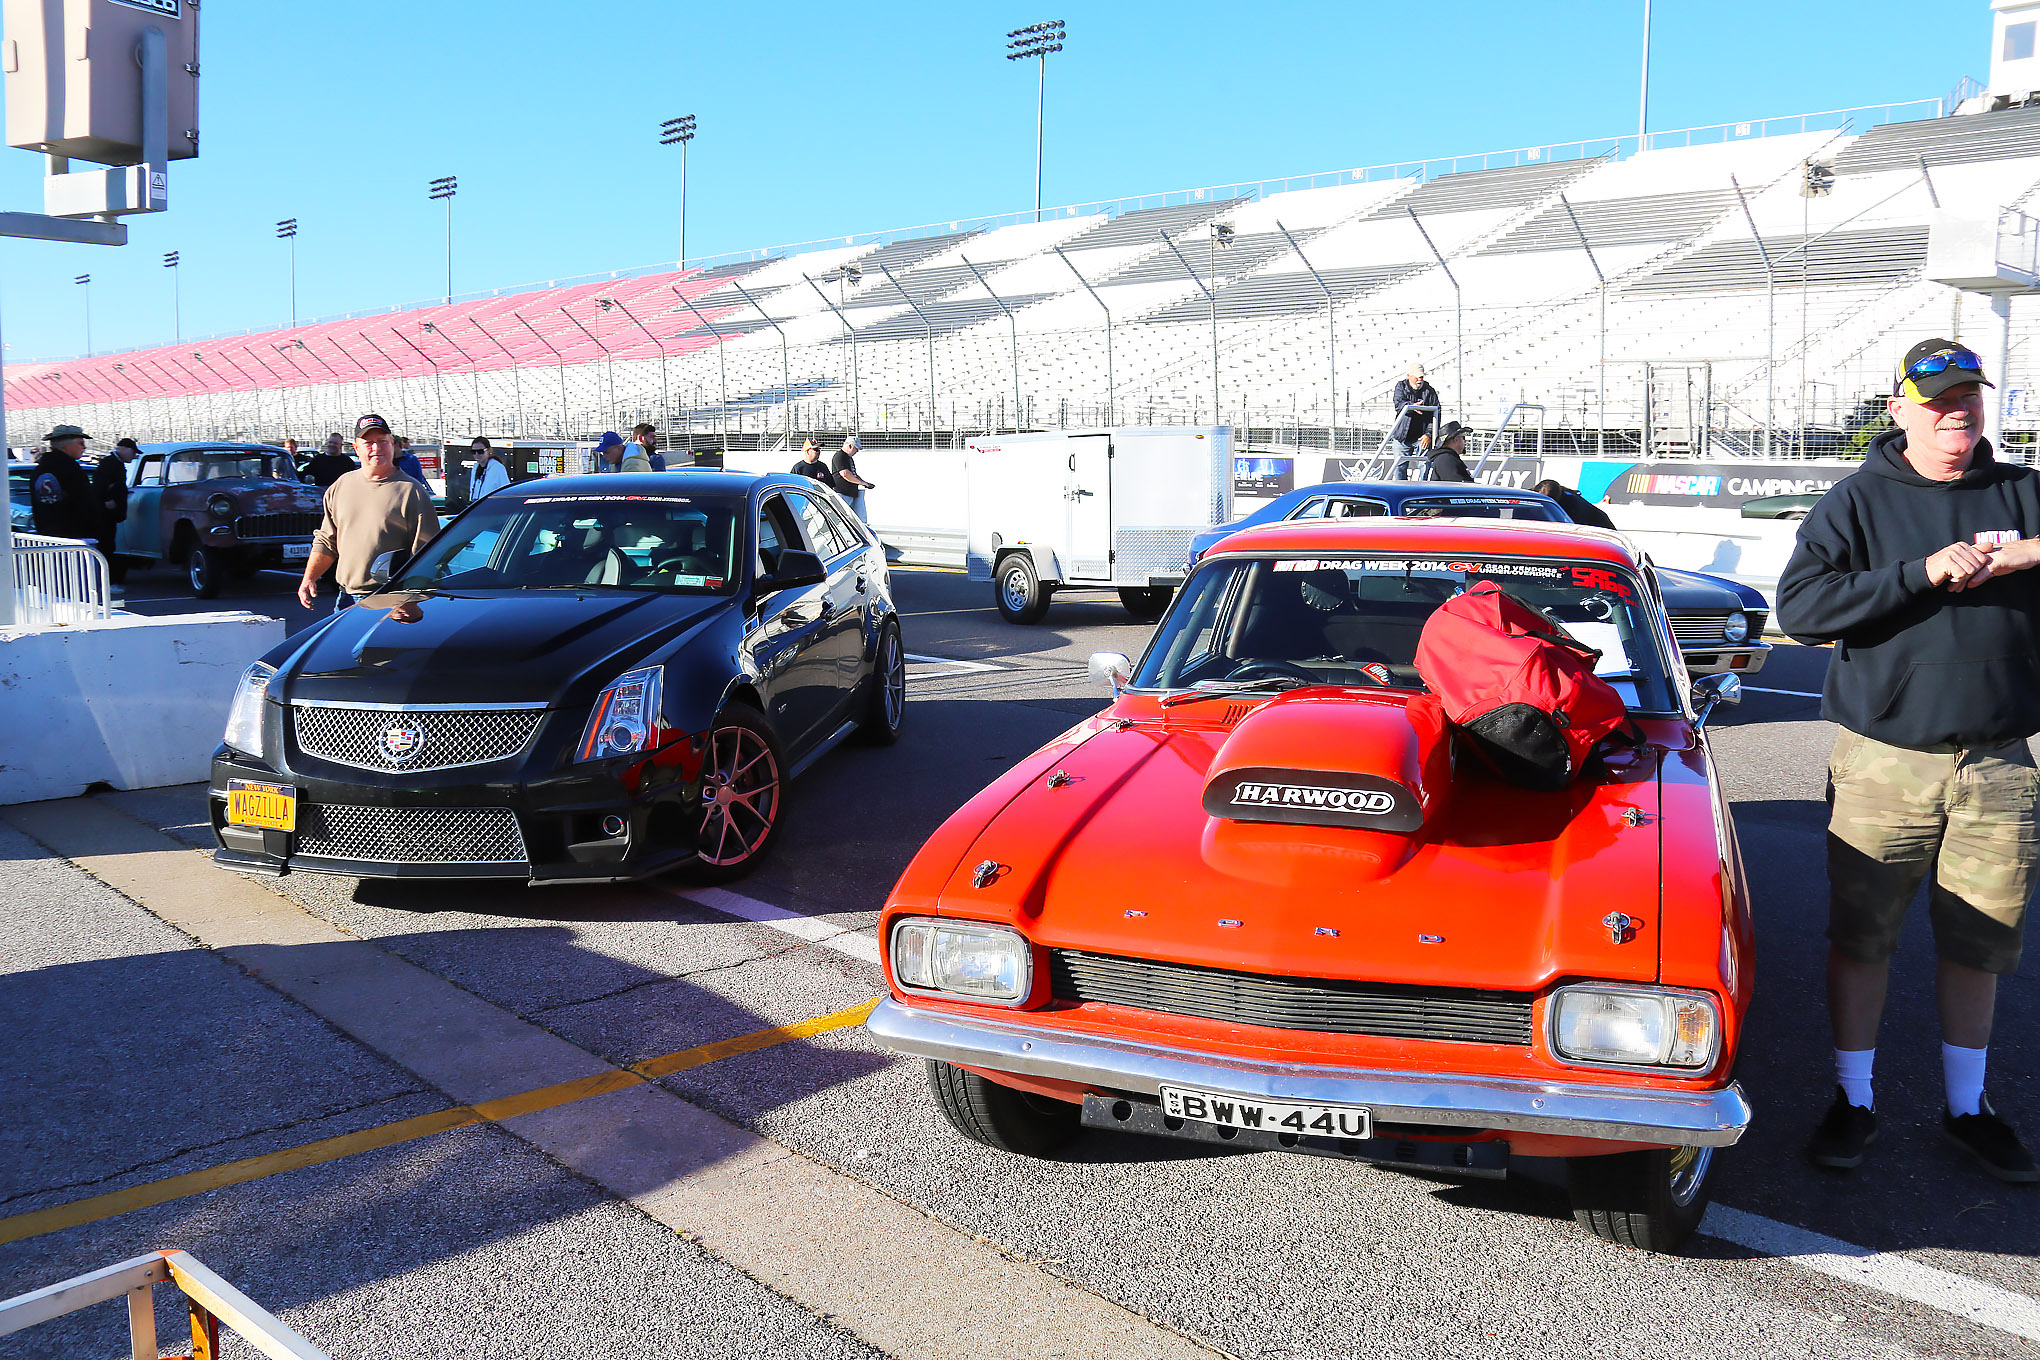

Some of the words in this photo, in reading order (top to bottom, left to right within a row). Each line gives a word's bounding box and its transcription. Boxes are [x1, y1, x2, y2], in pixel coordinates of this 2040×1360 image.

[1737, 124, 1748, 136] 31
[1528, 149, 1540, 160] 30
[538, 456, 557, 466] DRAG
[538, 465, 557, 474] WEEK
[1654, 475, 1719, 496] NASCAR
[1727, 478, 1815, 496] CAMPING
[1974, 531, 1999, 545] HOT
[1319, 560, 1364, 571] DRAG
[1363, 560, 1410, 571] WEEK
[1409, 560, 1448, 572] 2014
[1484, 563, 1511, 572] GEAR
[1512, 564, 1558, 574] VENDORS
[244, 783, 262, 792] NEW
[262, 785, 279, 794] YORK
[1241, 784, 1393, 811] HARWOOD
[234, 792, 289, 821] WAGZILLA
[1124, 908, 1447, 945] FORD
[1169, 1091, 1182, 1115] NSW
